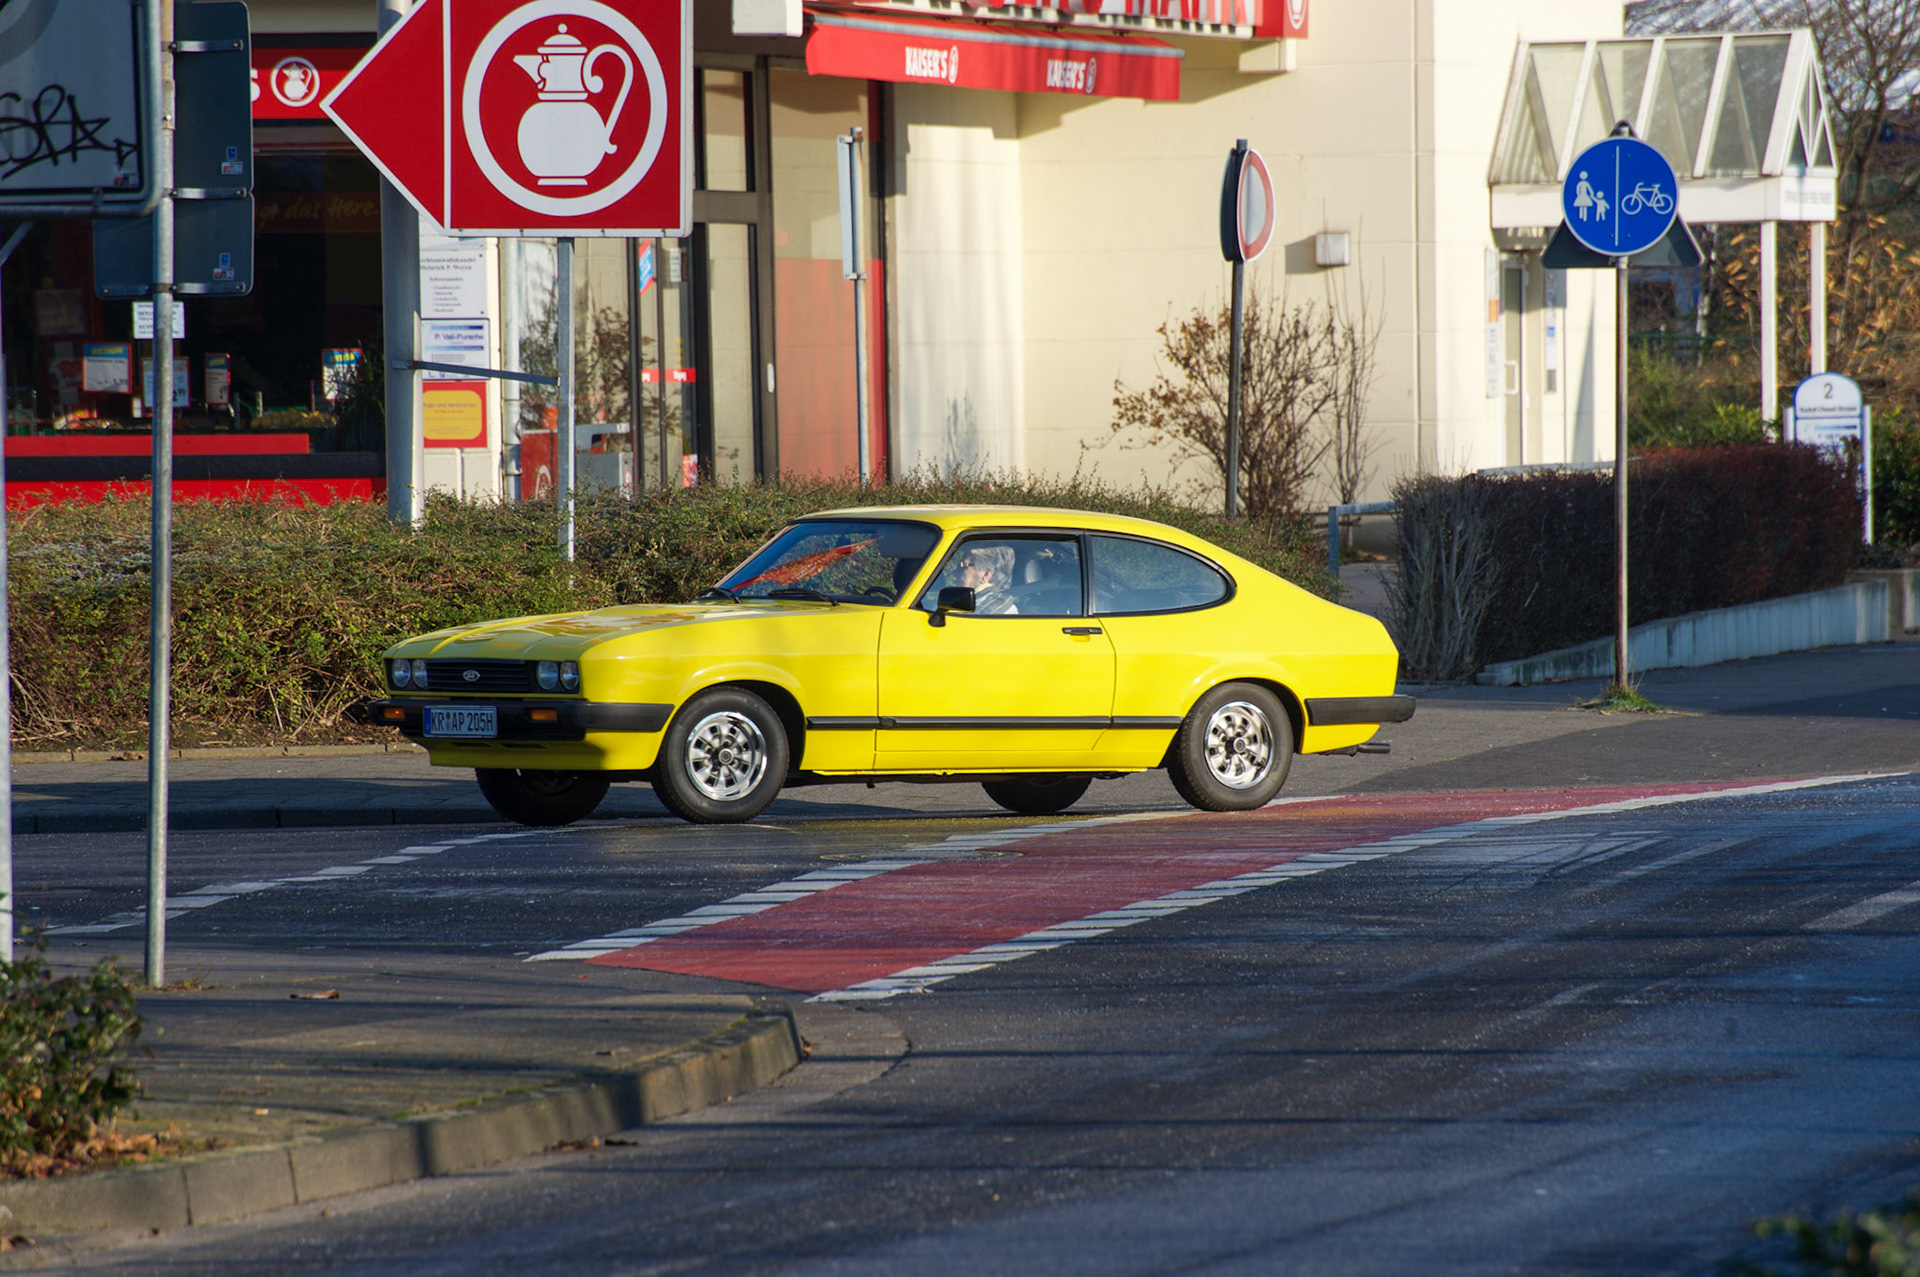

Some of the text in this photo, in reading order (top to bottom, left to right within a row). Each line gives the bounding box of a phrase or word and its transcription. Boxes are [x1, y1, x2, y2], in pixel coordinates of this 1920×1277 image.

[905, 46, 948, 79] KAISER'S
[1046, 59, 1086, 89] KAISER'S
[1823, 382, 1834, 400] 2
[467, 711, 494, 732] 205H
